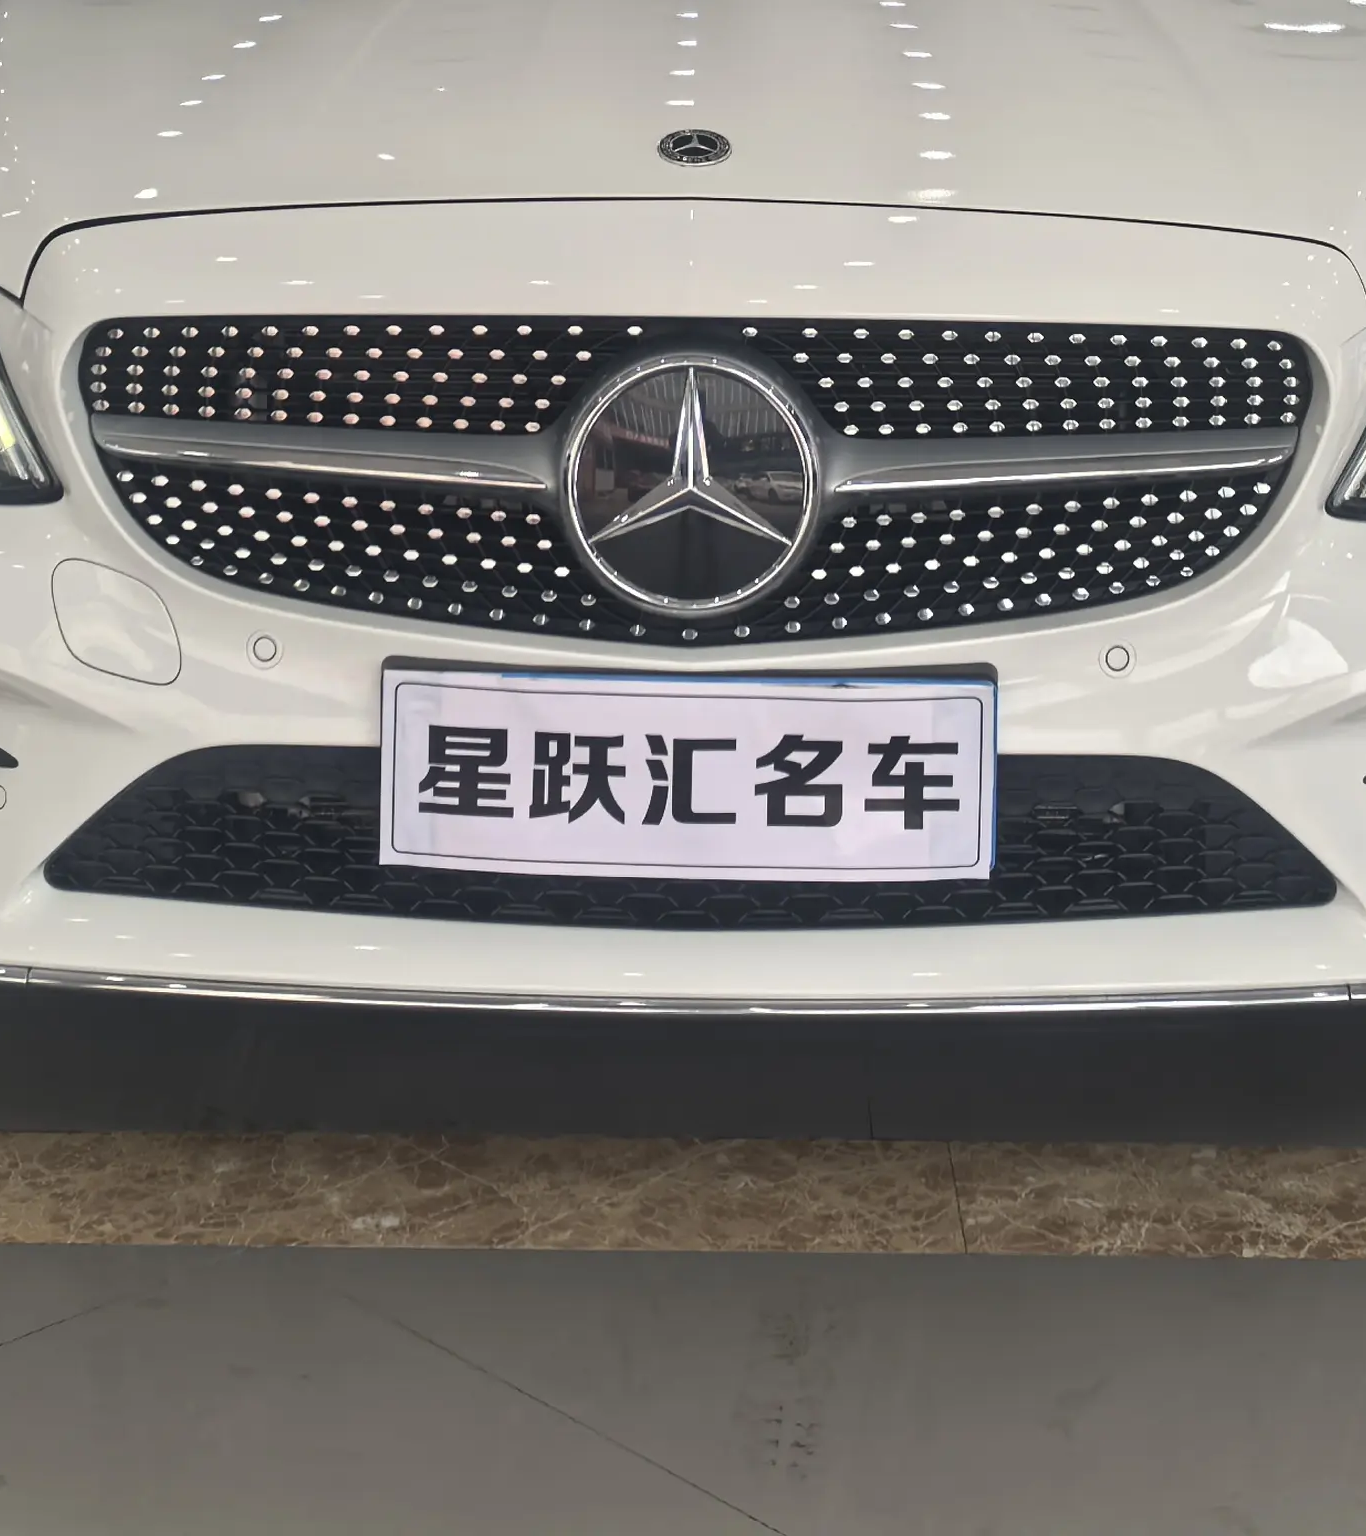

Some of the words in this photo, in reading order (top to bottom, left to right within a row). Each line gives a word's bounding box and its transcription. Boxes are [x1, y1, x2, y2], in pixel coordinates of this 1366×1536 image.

[417, 724, 961, 832] 星跃汇名车
